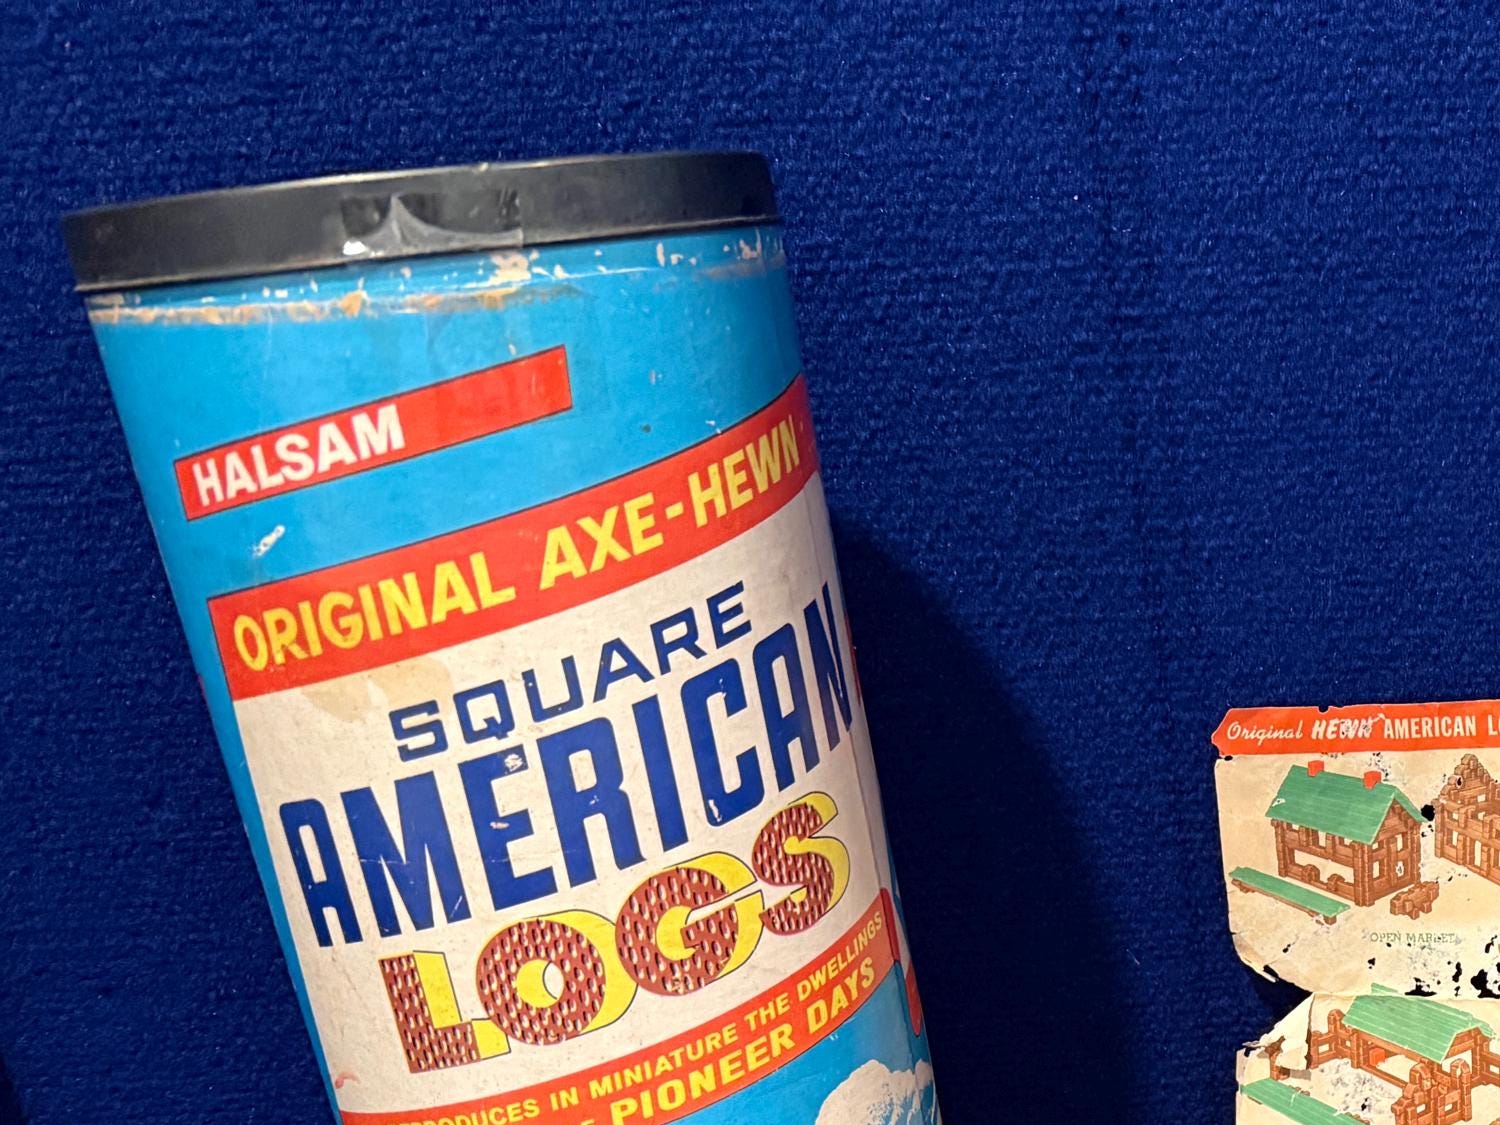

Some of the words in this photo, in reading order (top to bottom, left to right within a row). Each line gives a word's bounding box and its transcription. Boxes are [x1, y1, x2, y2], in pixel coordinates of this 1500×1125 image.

[193, 403, 405, 507] HALSAM
[233, 550, 517, 672] ORIGINAL
[539, 416, 801, 591] AXE-HEWN
[389, 581, 752, 762] SQUARE
[1226, 720, 1303, 746] Original
[1383, 714, 1477, 740] AMERICAN
[279, 581, 853, 947] AMERICAN
[378, 791, 850, 1073] LOGS
[550, 1085, 580, 1112] IN
[589, 1024, 739, 1100] MINIATURE
[744, 992, 790, 1032] THE
[797, 911, 883, 1002] DWELLINGS
[806, 957, 876, 1036] DAYS
[1369, 931, 1402, 943] OPEN
